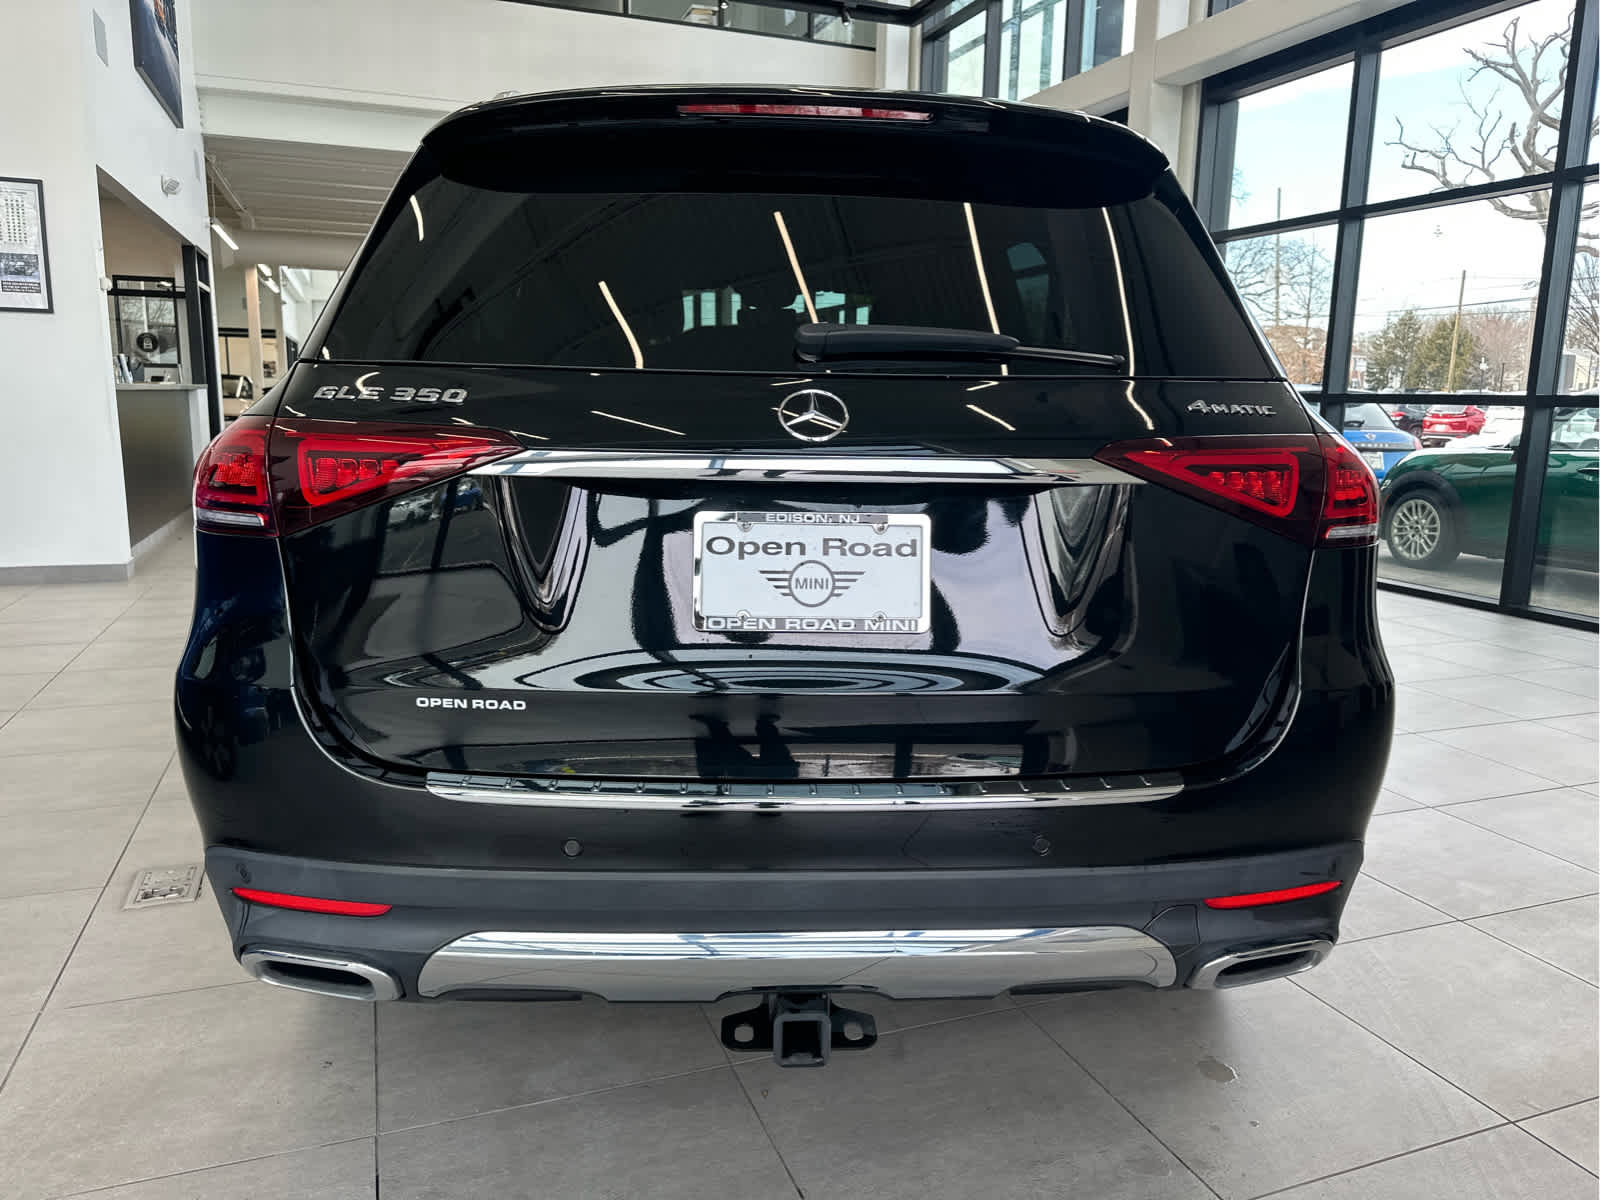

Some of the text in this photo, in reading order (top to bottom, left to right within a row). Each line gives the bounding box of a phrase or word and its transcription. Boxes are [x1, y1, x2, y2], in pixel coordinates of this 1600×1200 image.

[313, 385, 468, 403] GLE 350
[839, 514, 860, 523] NJ
[706, 536, 917, 560] Open Road
[794, 578, 829, 590] MINI
[707, 618, 918, 631] OPEN ROAD MINI
[416, 697, 527, 710] OPEN ROAD
